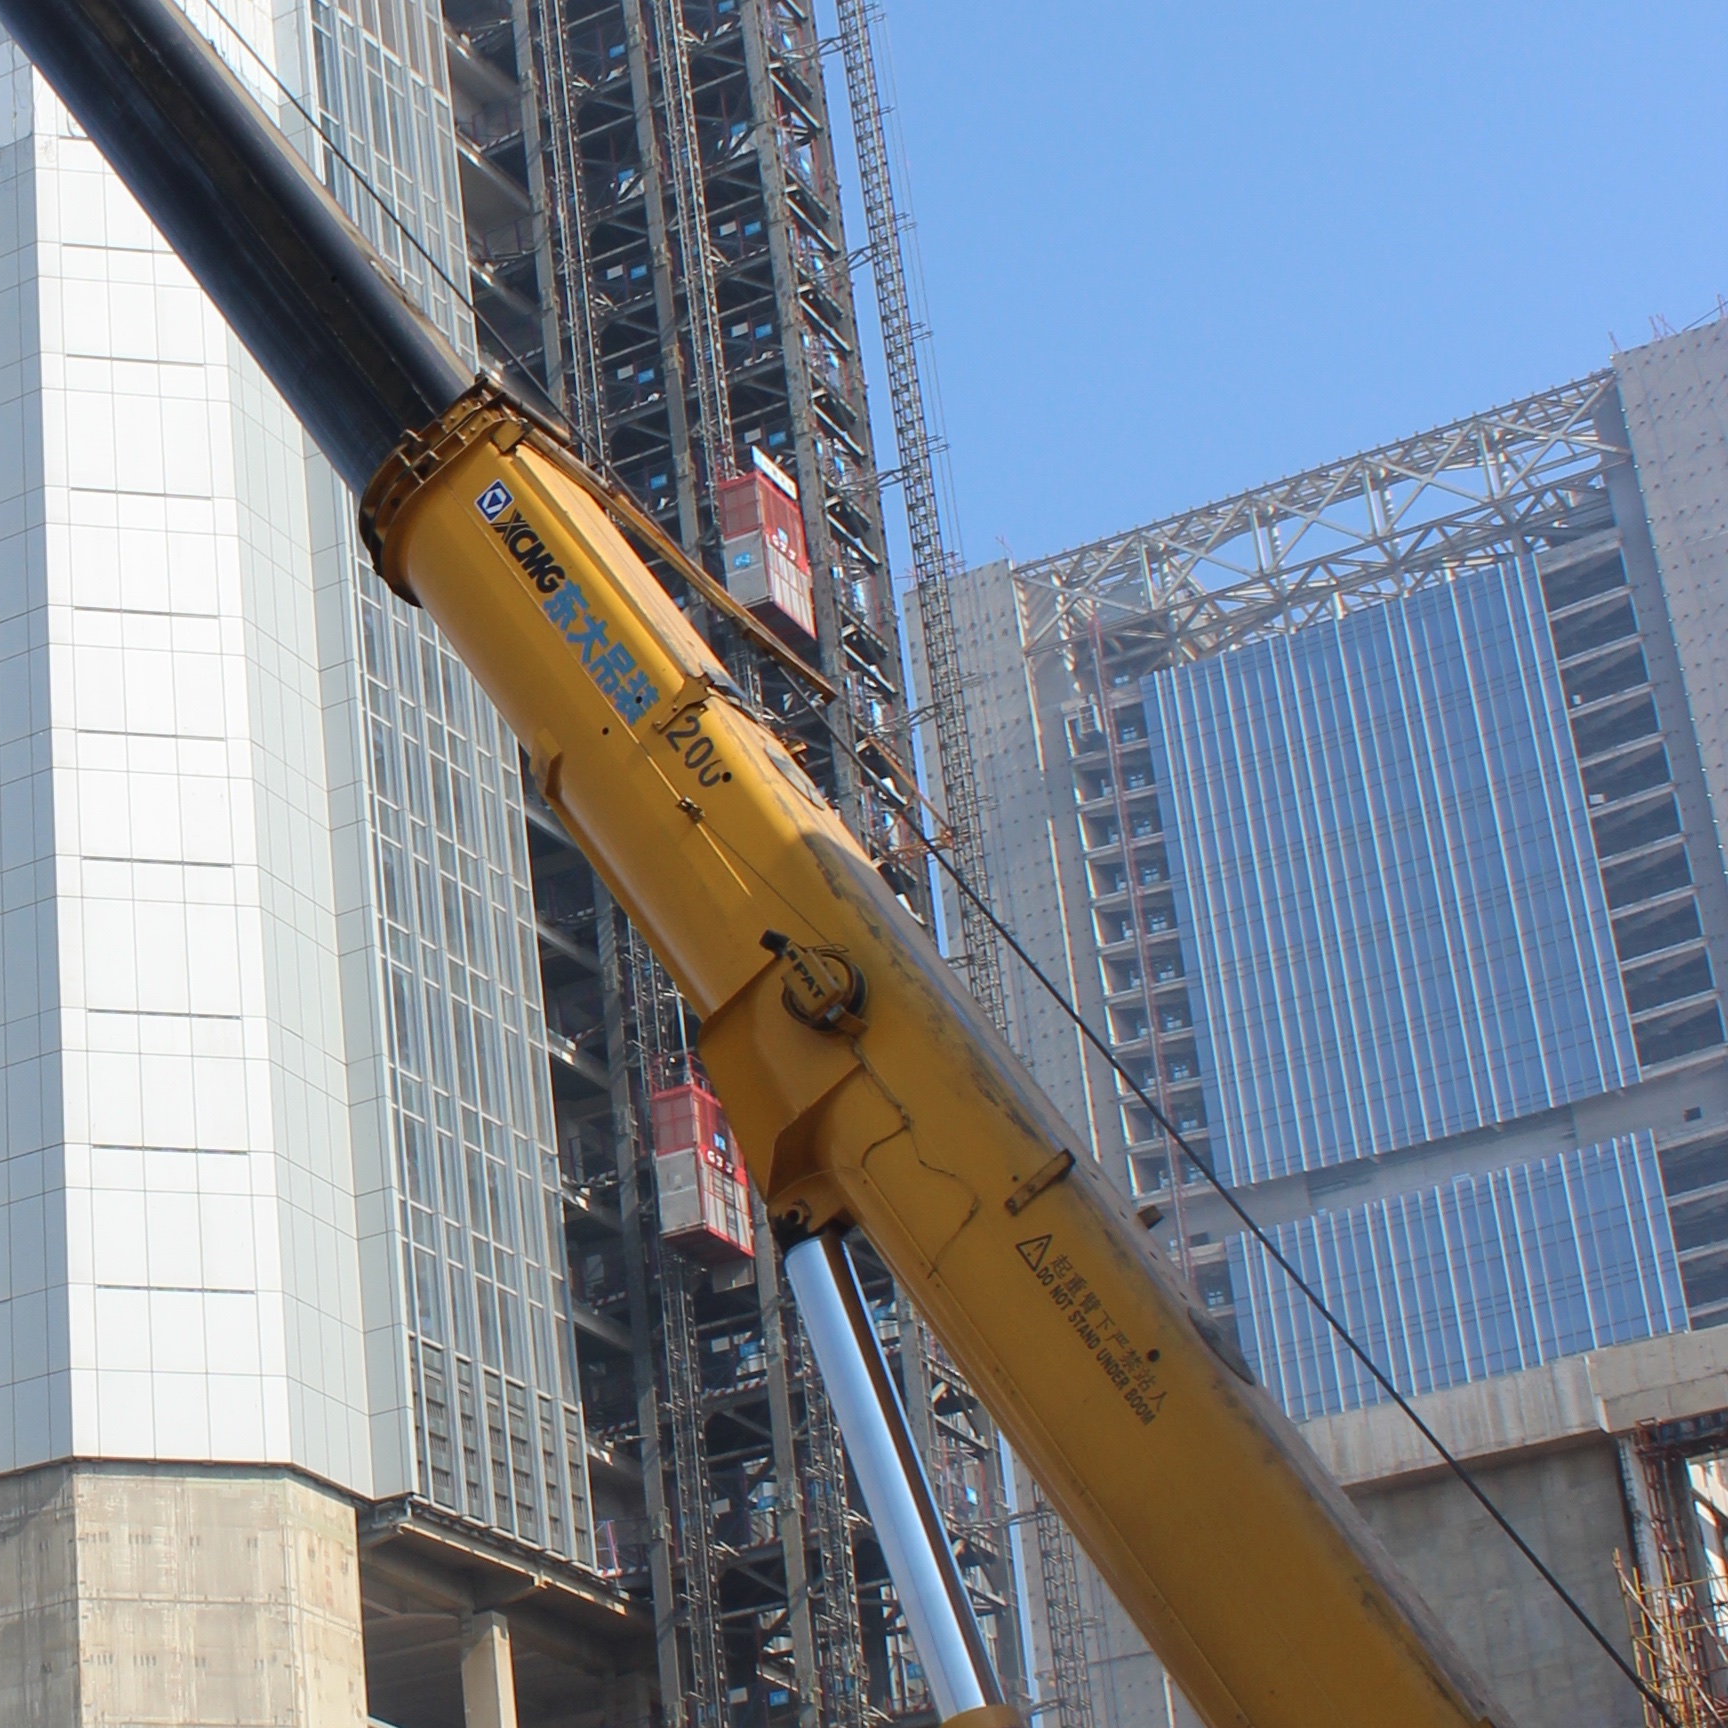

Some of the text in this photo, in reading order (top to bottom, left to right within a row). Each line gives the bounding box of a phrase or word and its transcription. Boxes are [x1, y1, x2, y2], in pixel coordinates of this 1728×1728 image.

[491, 509, 565, 593] XCMG
[543, 579, 660, 726] 东大吊装
[793, 960, 826, 998] PAT
[1036, 1266, 1156, 1425] DO NOT STAND UNDER BOOM
[1051, 1254, 1167, 1412] 起重臂下严禁站人
